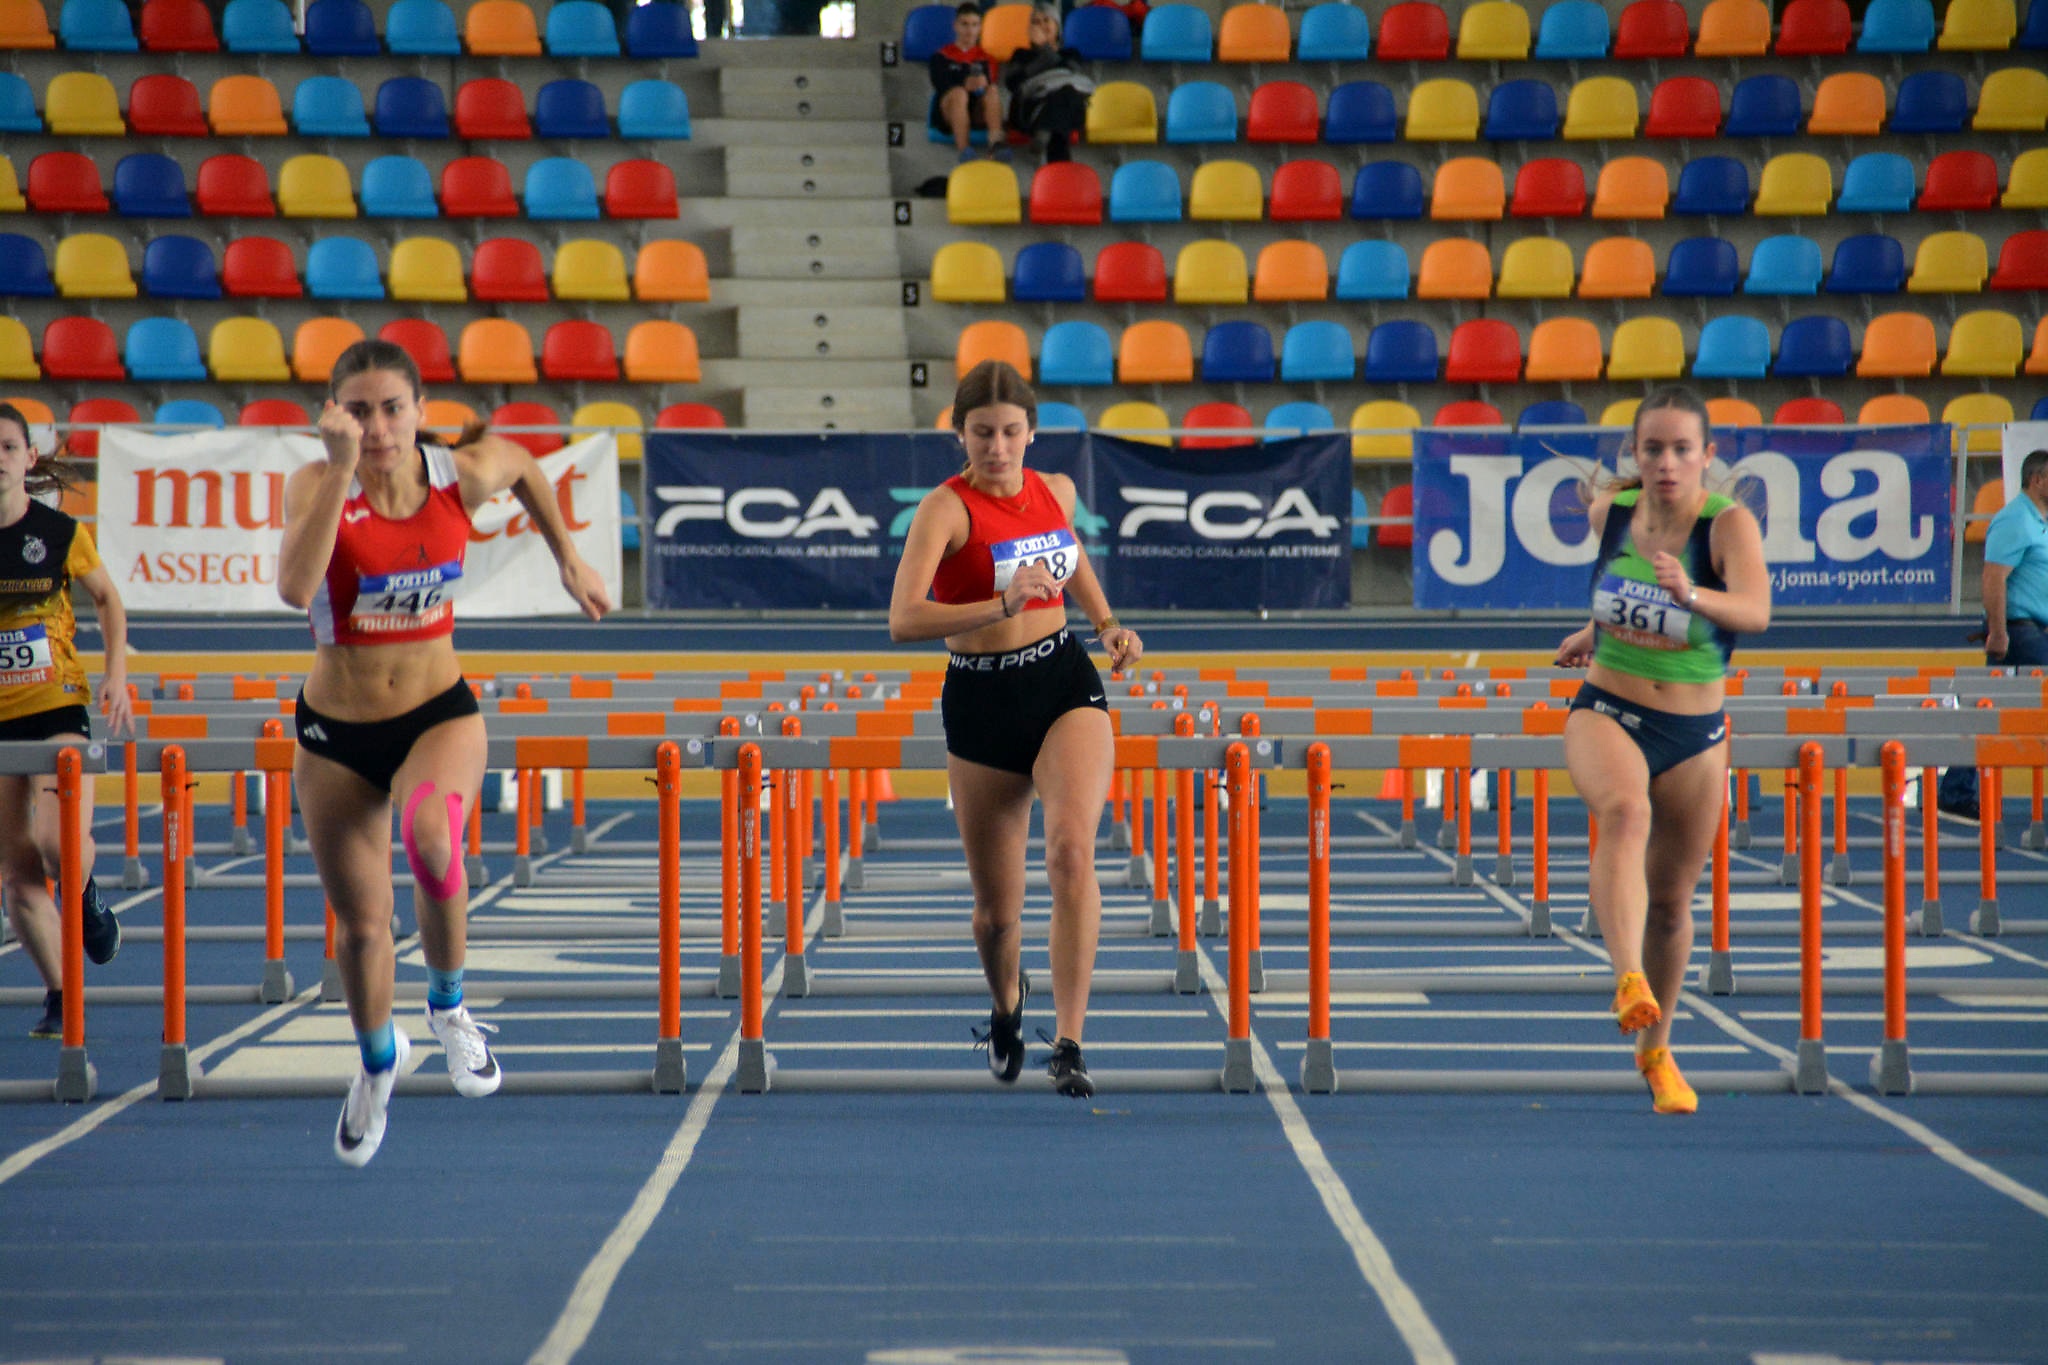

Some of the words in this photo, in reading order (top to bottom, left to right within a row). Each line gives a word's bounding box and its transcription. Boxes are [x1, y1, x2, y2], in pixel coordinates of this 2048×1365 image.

[655, 486, 879, 537] FCA
[1119, 487, 1340, 539] FCA
[1014, 533, 1060, 557] Joma
[129, 551, 278, 585] ASSEGU
[1769, 566, 1936, 592] .joma-sport.com
[1609, 598, 1669, 635] 361
[0, 628, 26, 643] ma
[0, 644, 35, 669] 59
[1000, 638, 1055, 670] PRO
[0, 669, 47, 685] uacat
